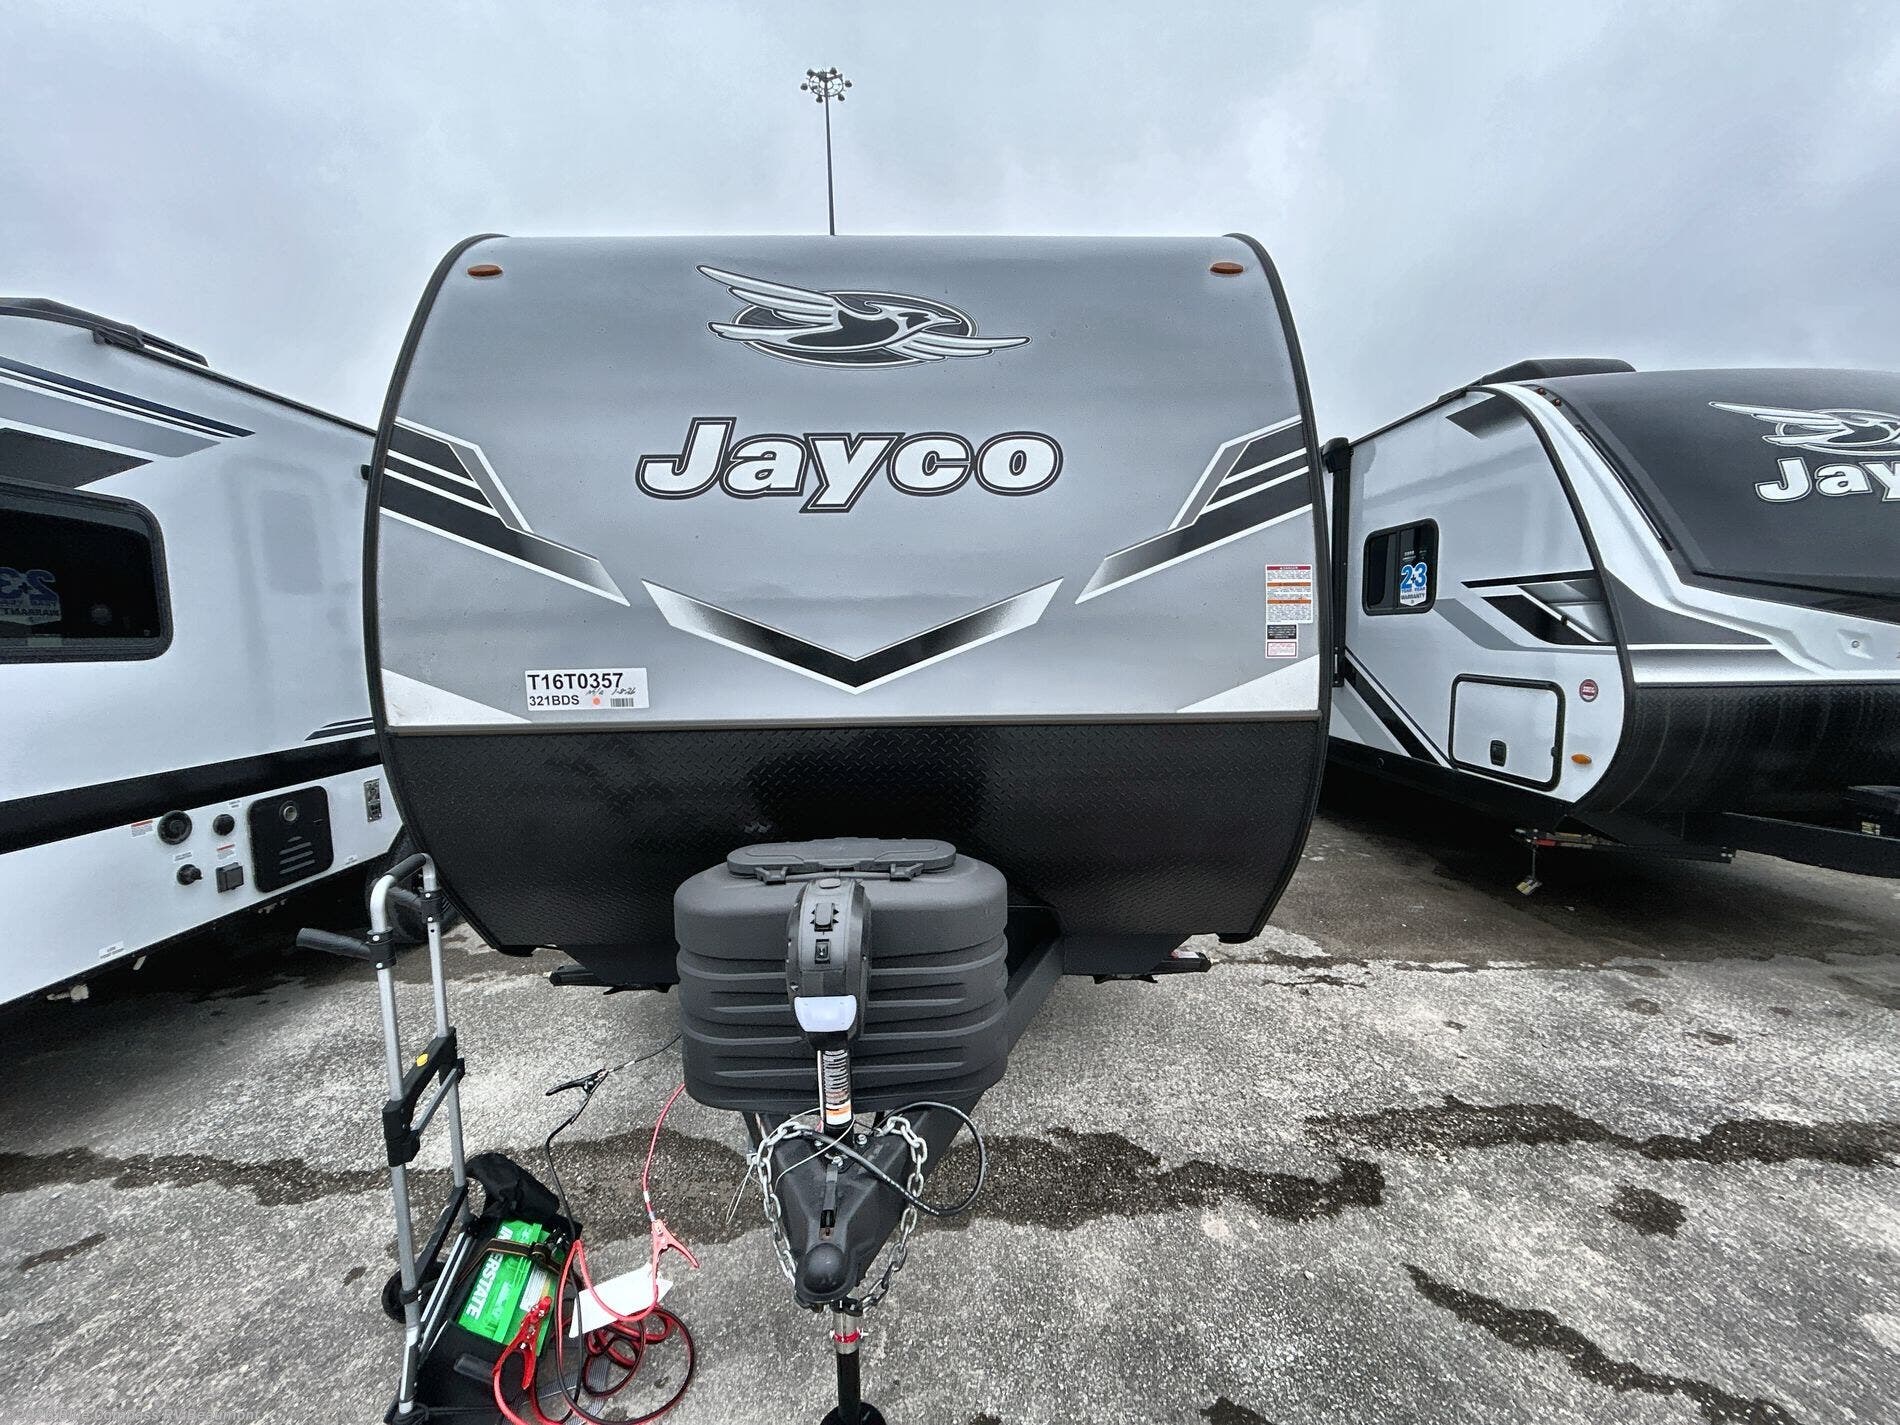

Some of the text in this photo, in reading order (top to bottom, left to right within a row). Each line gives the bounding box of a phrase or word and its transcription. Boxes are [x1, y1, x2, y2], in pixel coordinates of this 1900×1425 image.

[635, 416, 1064, 513] Jayco
[527, 673, 623, 689] T16T0357
[529, 695, 580, 706] 321BDS
